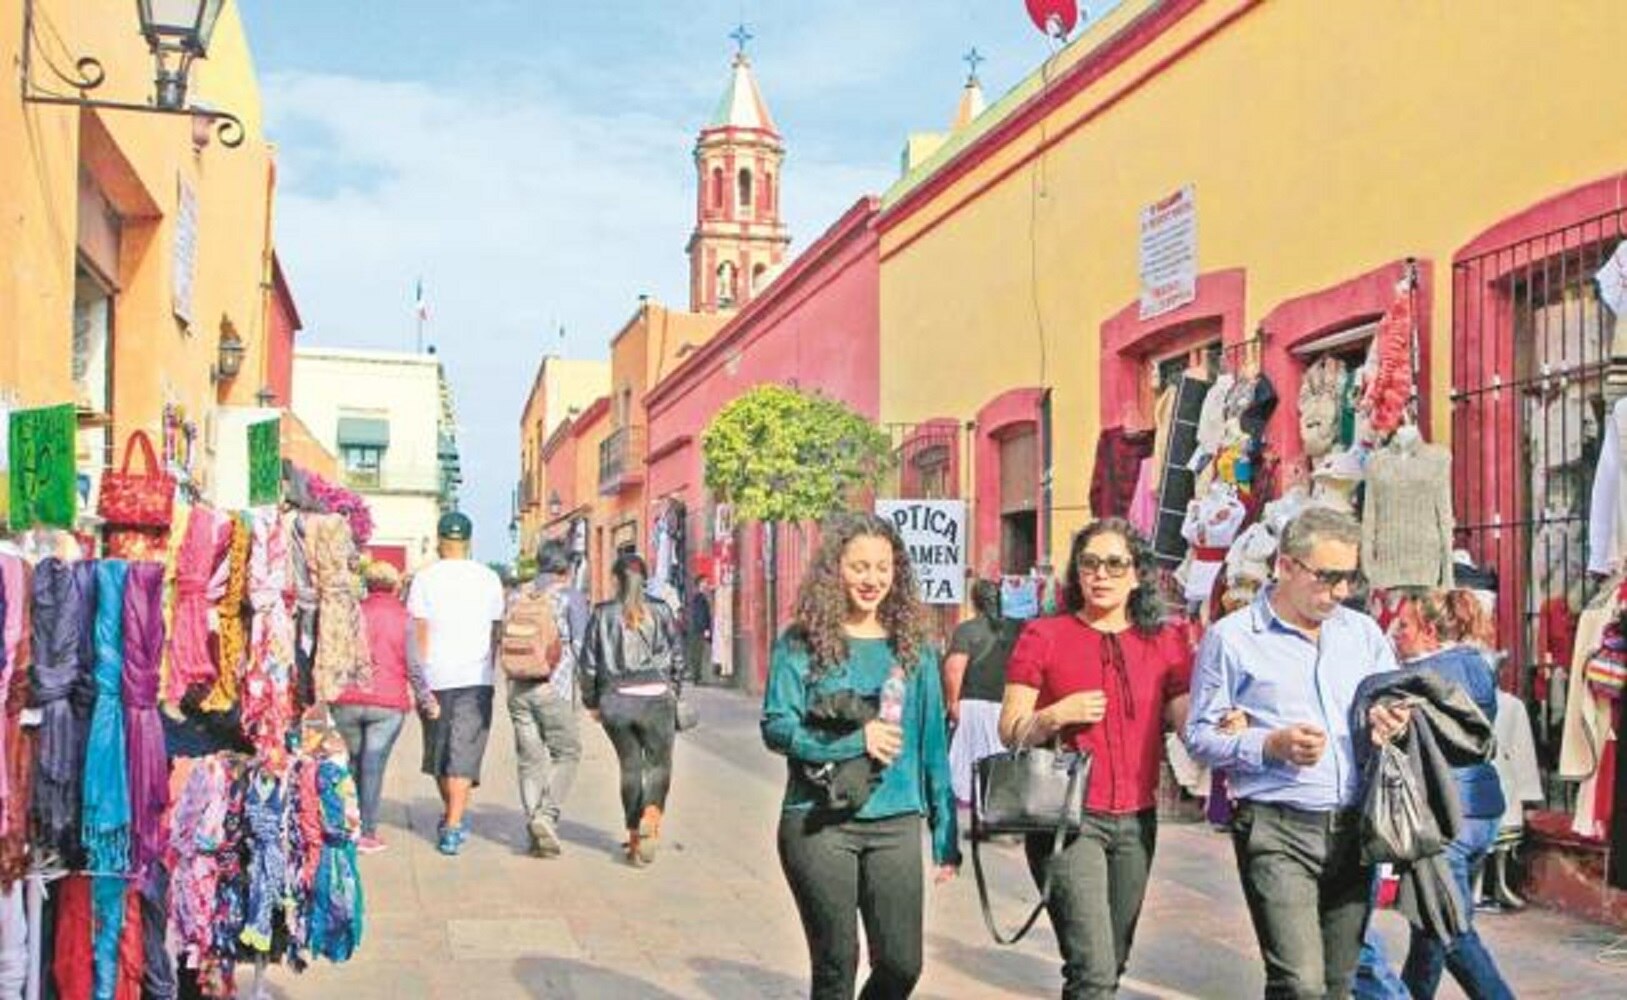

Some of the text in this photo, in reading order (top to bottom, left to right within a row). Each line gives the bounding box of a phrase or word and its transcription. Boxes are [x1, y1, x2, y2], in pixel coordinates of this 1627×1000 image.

[892, 504, 958, 545] PTICA
[909, 544, 960, 565] AMEN
[921, 578, 954, 599] TA
